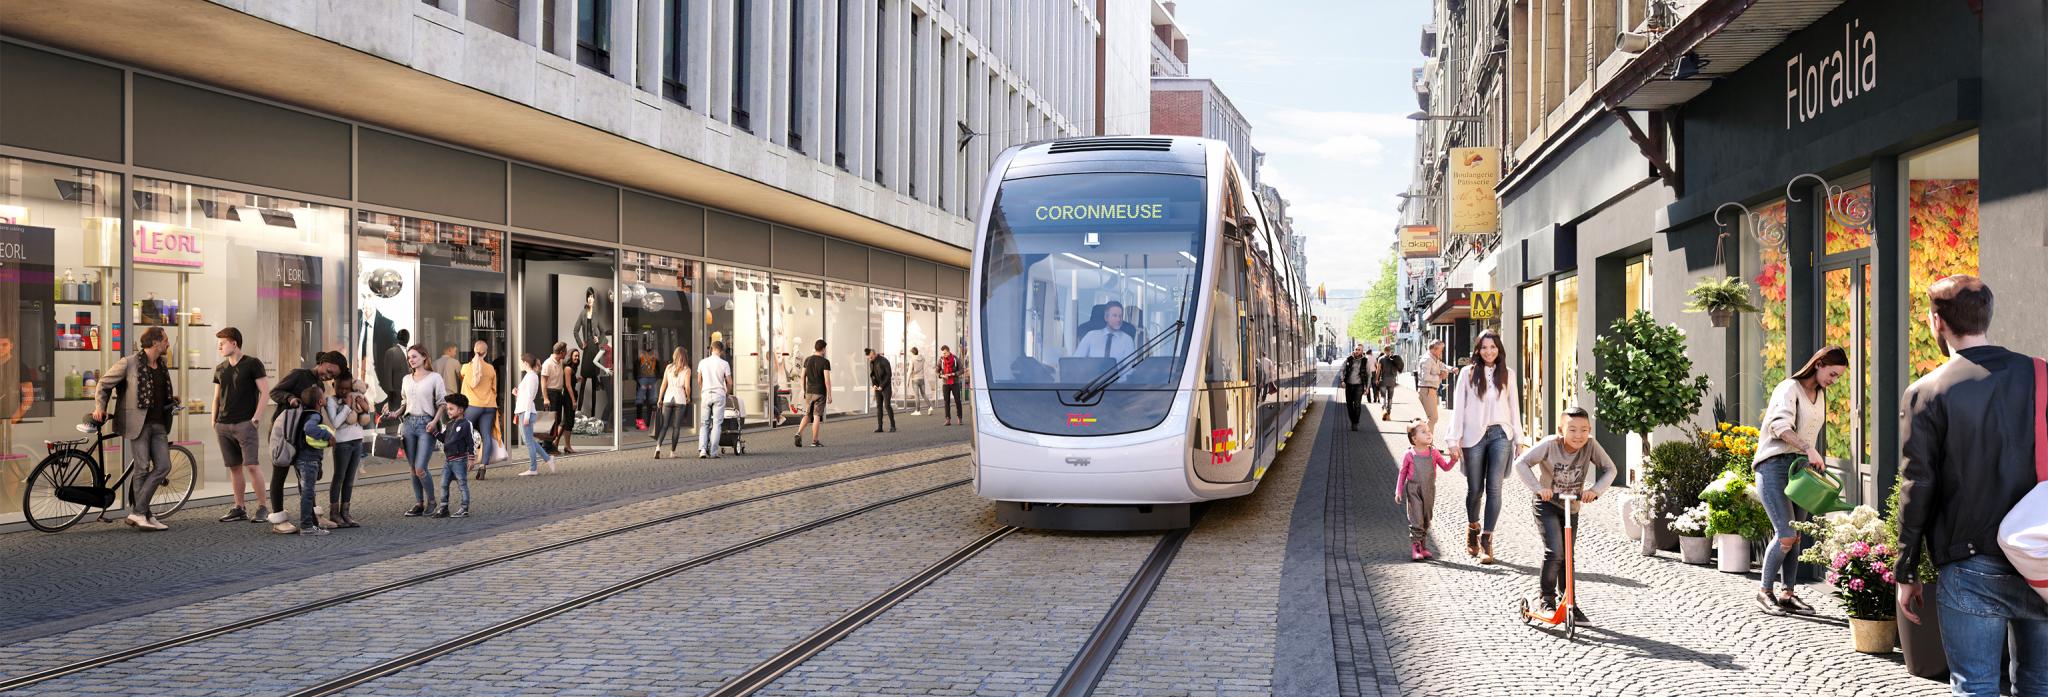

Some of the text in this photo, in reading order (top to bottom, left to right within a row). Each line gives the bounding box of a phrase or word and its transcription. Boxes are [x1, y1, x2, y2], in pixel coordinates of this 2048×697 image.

[1786, 18, 1877, 130] Floralia
[1453, 171, 1494, 179] Boulangerie
[1035, 204, 1163, 221] CORONMEUSE
[132, 224, 201, 255] 'LEORL
[1474, 293, 1497, 310] M
[1065, 412, 1096, 428] TEC
[1211, 428, 1234, 465] TEC
